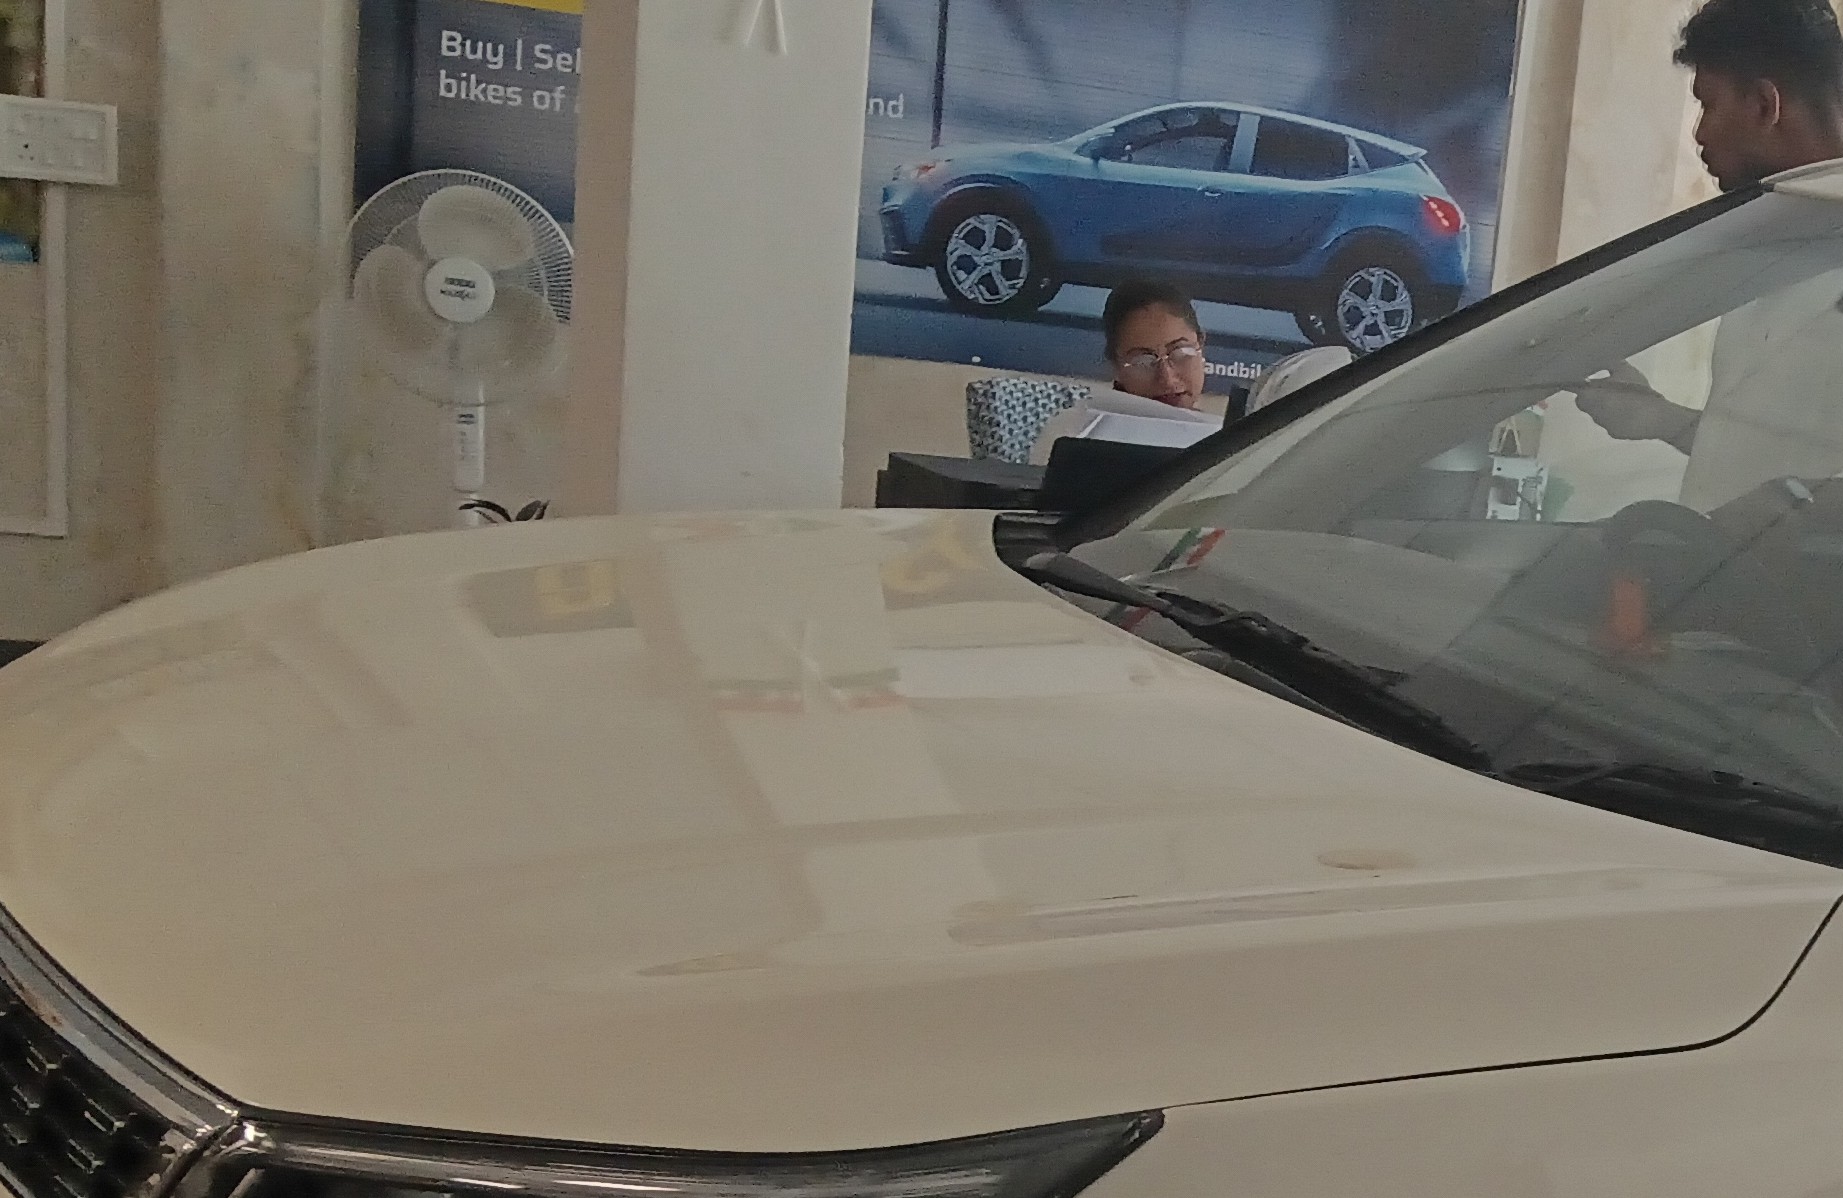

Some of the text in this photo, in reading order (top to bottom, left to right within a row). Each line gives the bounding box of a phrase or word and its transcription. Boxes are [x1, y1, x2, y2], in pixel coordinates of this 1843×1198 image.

[440, 29, 505, 70] Buy
[438, 69, 523, 107] bikes
[532, 85, 566, 112] of
